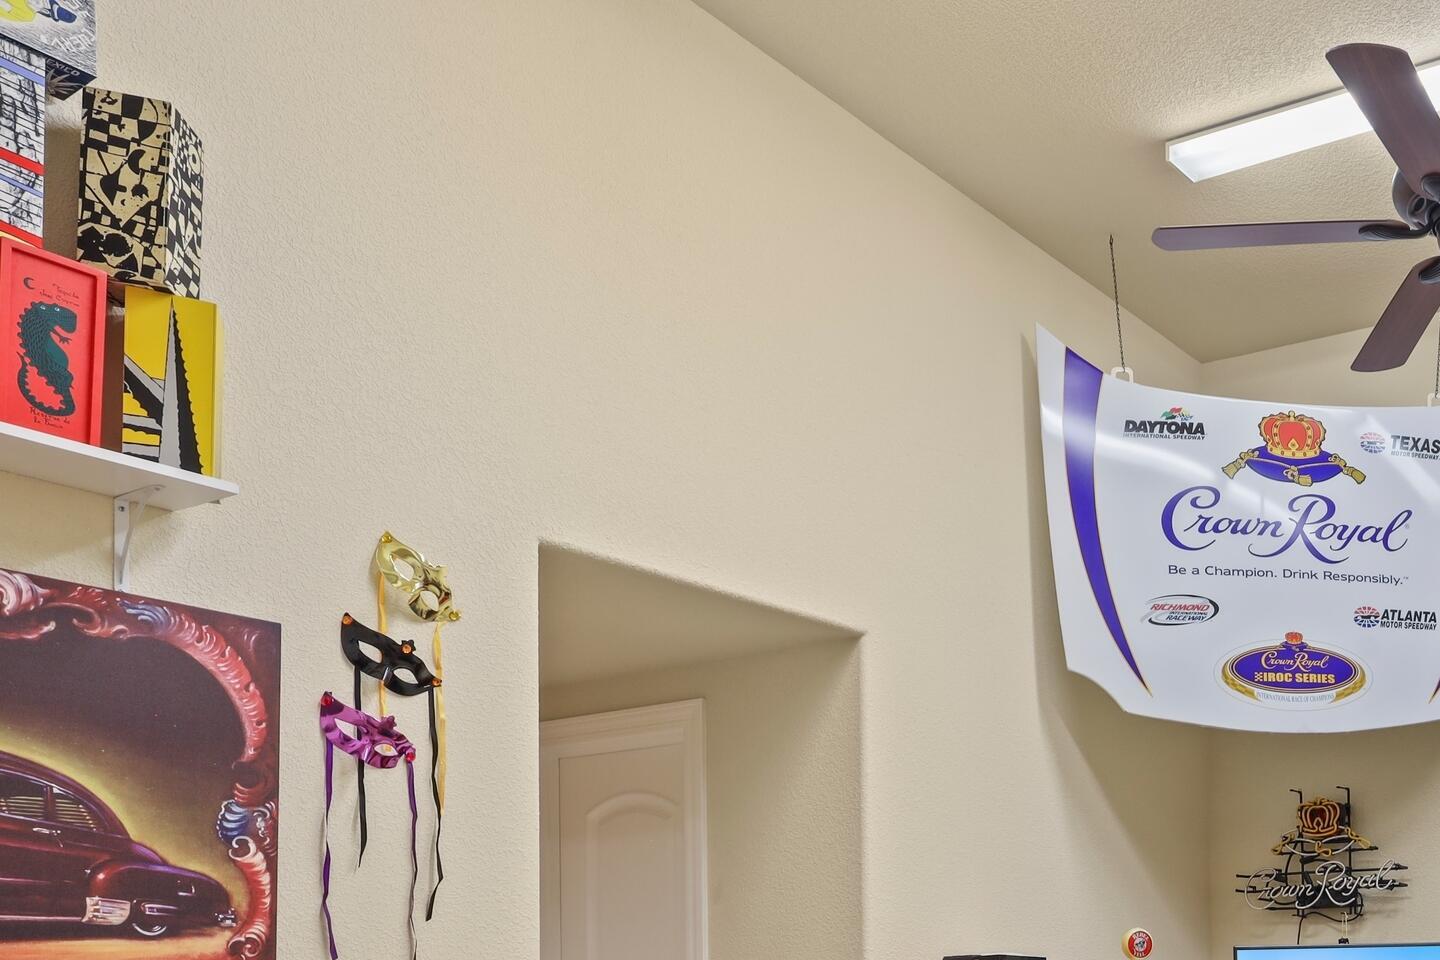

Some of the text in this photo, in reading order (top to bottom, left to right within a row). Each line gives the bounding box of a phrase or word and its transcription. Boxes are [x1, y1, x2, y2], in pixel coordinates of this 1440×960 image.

[46, 59, 80, 76] EXICO
[1124, 420, 1205, 436] DAYTONA
[1391, 434, 1440, 454] TEXAS
[1160, 485, 1413, 564] Crown Royal
[1168, 564, 1403, 586] Be a Champion. Drink Responsibly.
[1150, 603, 1210, 611] RICHMOND
[1381, 609, 1437, 623] ATLANTA
[1380, 621, 1437, 631] MOTOR SPEEDWAY
[1261, 650, 1330, 672] Crown Royal
[1263, 672, 1336, 684] IROC SERIES
[1245, 858, 1400, 910] Crown Royal
